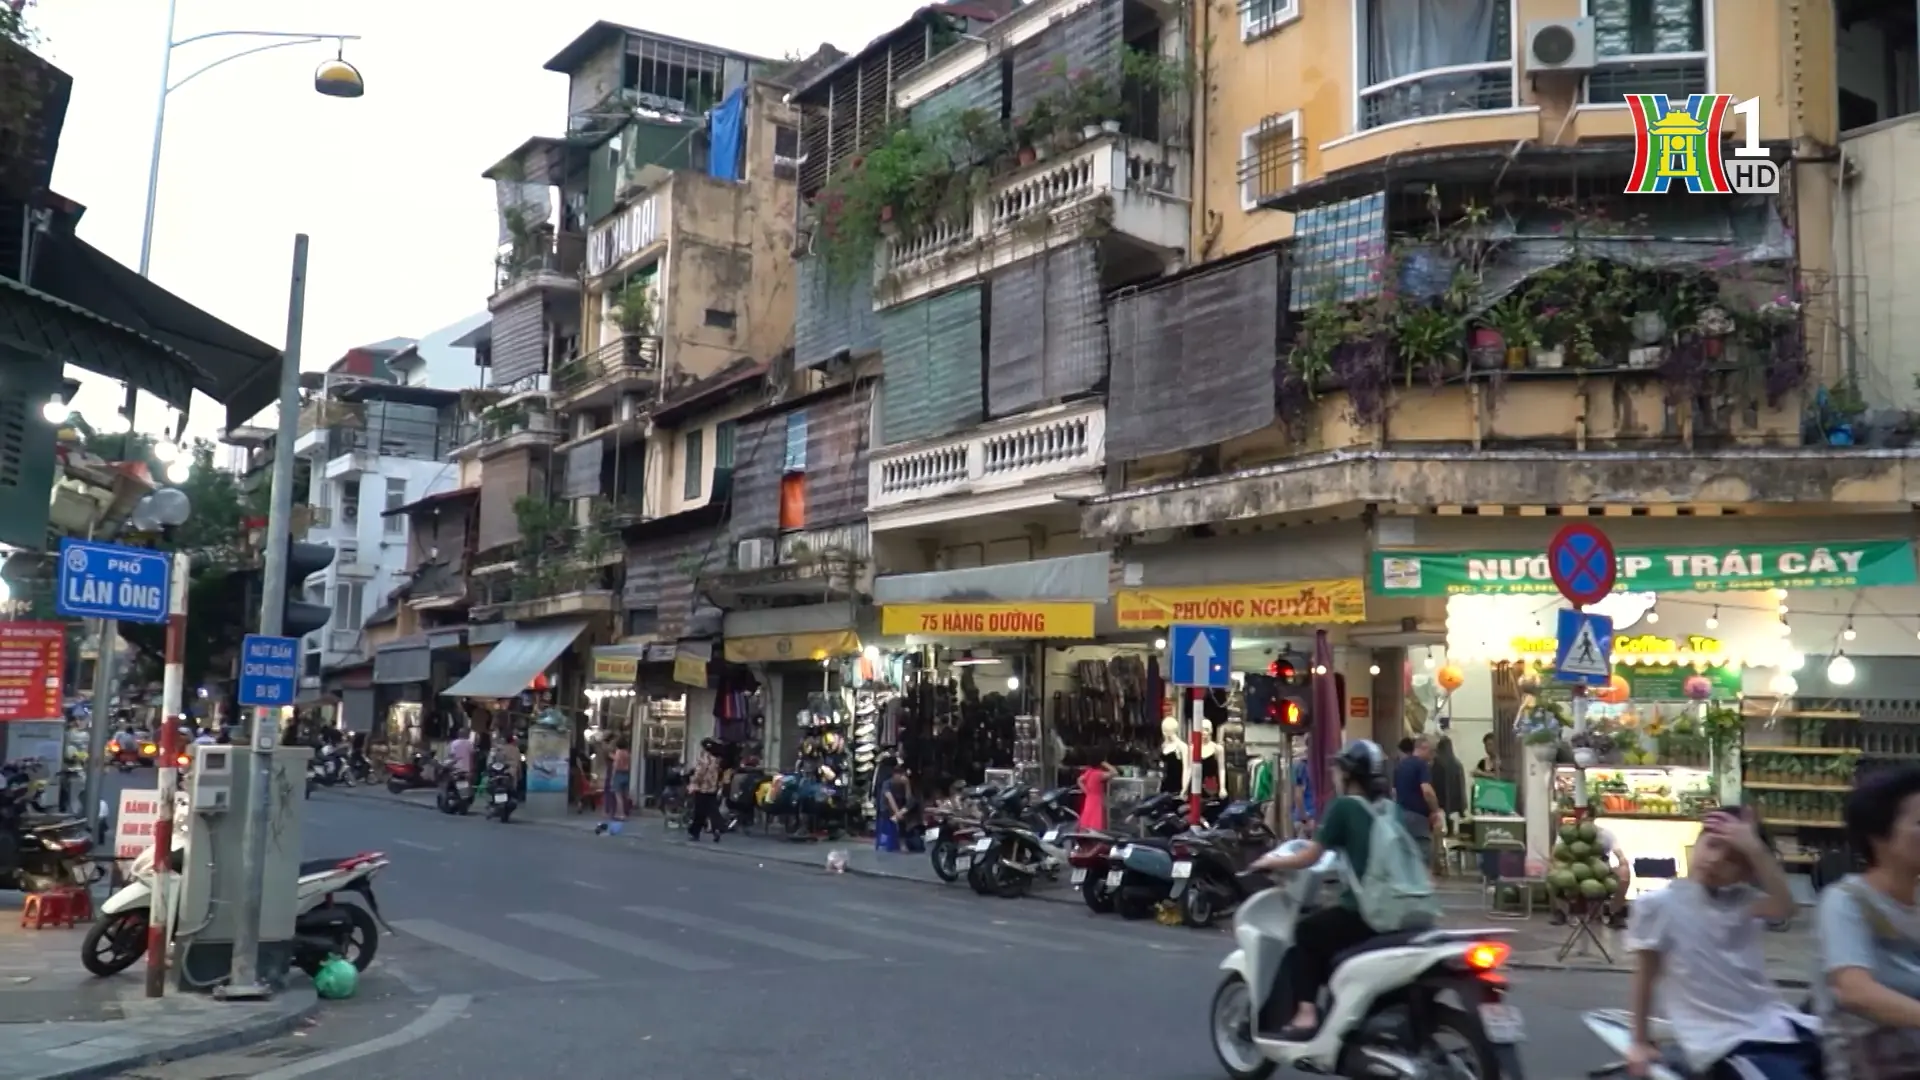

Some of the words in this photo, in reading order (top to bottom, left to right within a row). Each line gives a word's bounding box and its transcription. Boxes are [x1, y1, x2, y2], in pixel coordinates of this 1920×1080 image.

[107, 558, 142, 575] PHỐ
[1468, 553, 1551, 581] NƯỚ
[1664, 549, 1763, 577] TRÁI
[1778, 547, 1865, 574] CÂY
[119, 577, 161, 610] ÔNG
[1172, 595, 1245, 620] PHƯƠNG
[920, 613, 938, 631] 75
[942, 609, 984, 632] HÀNG
